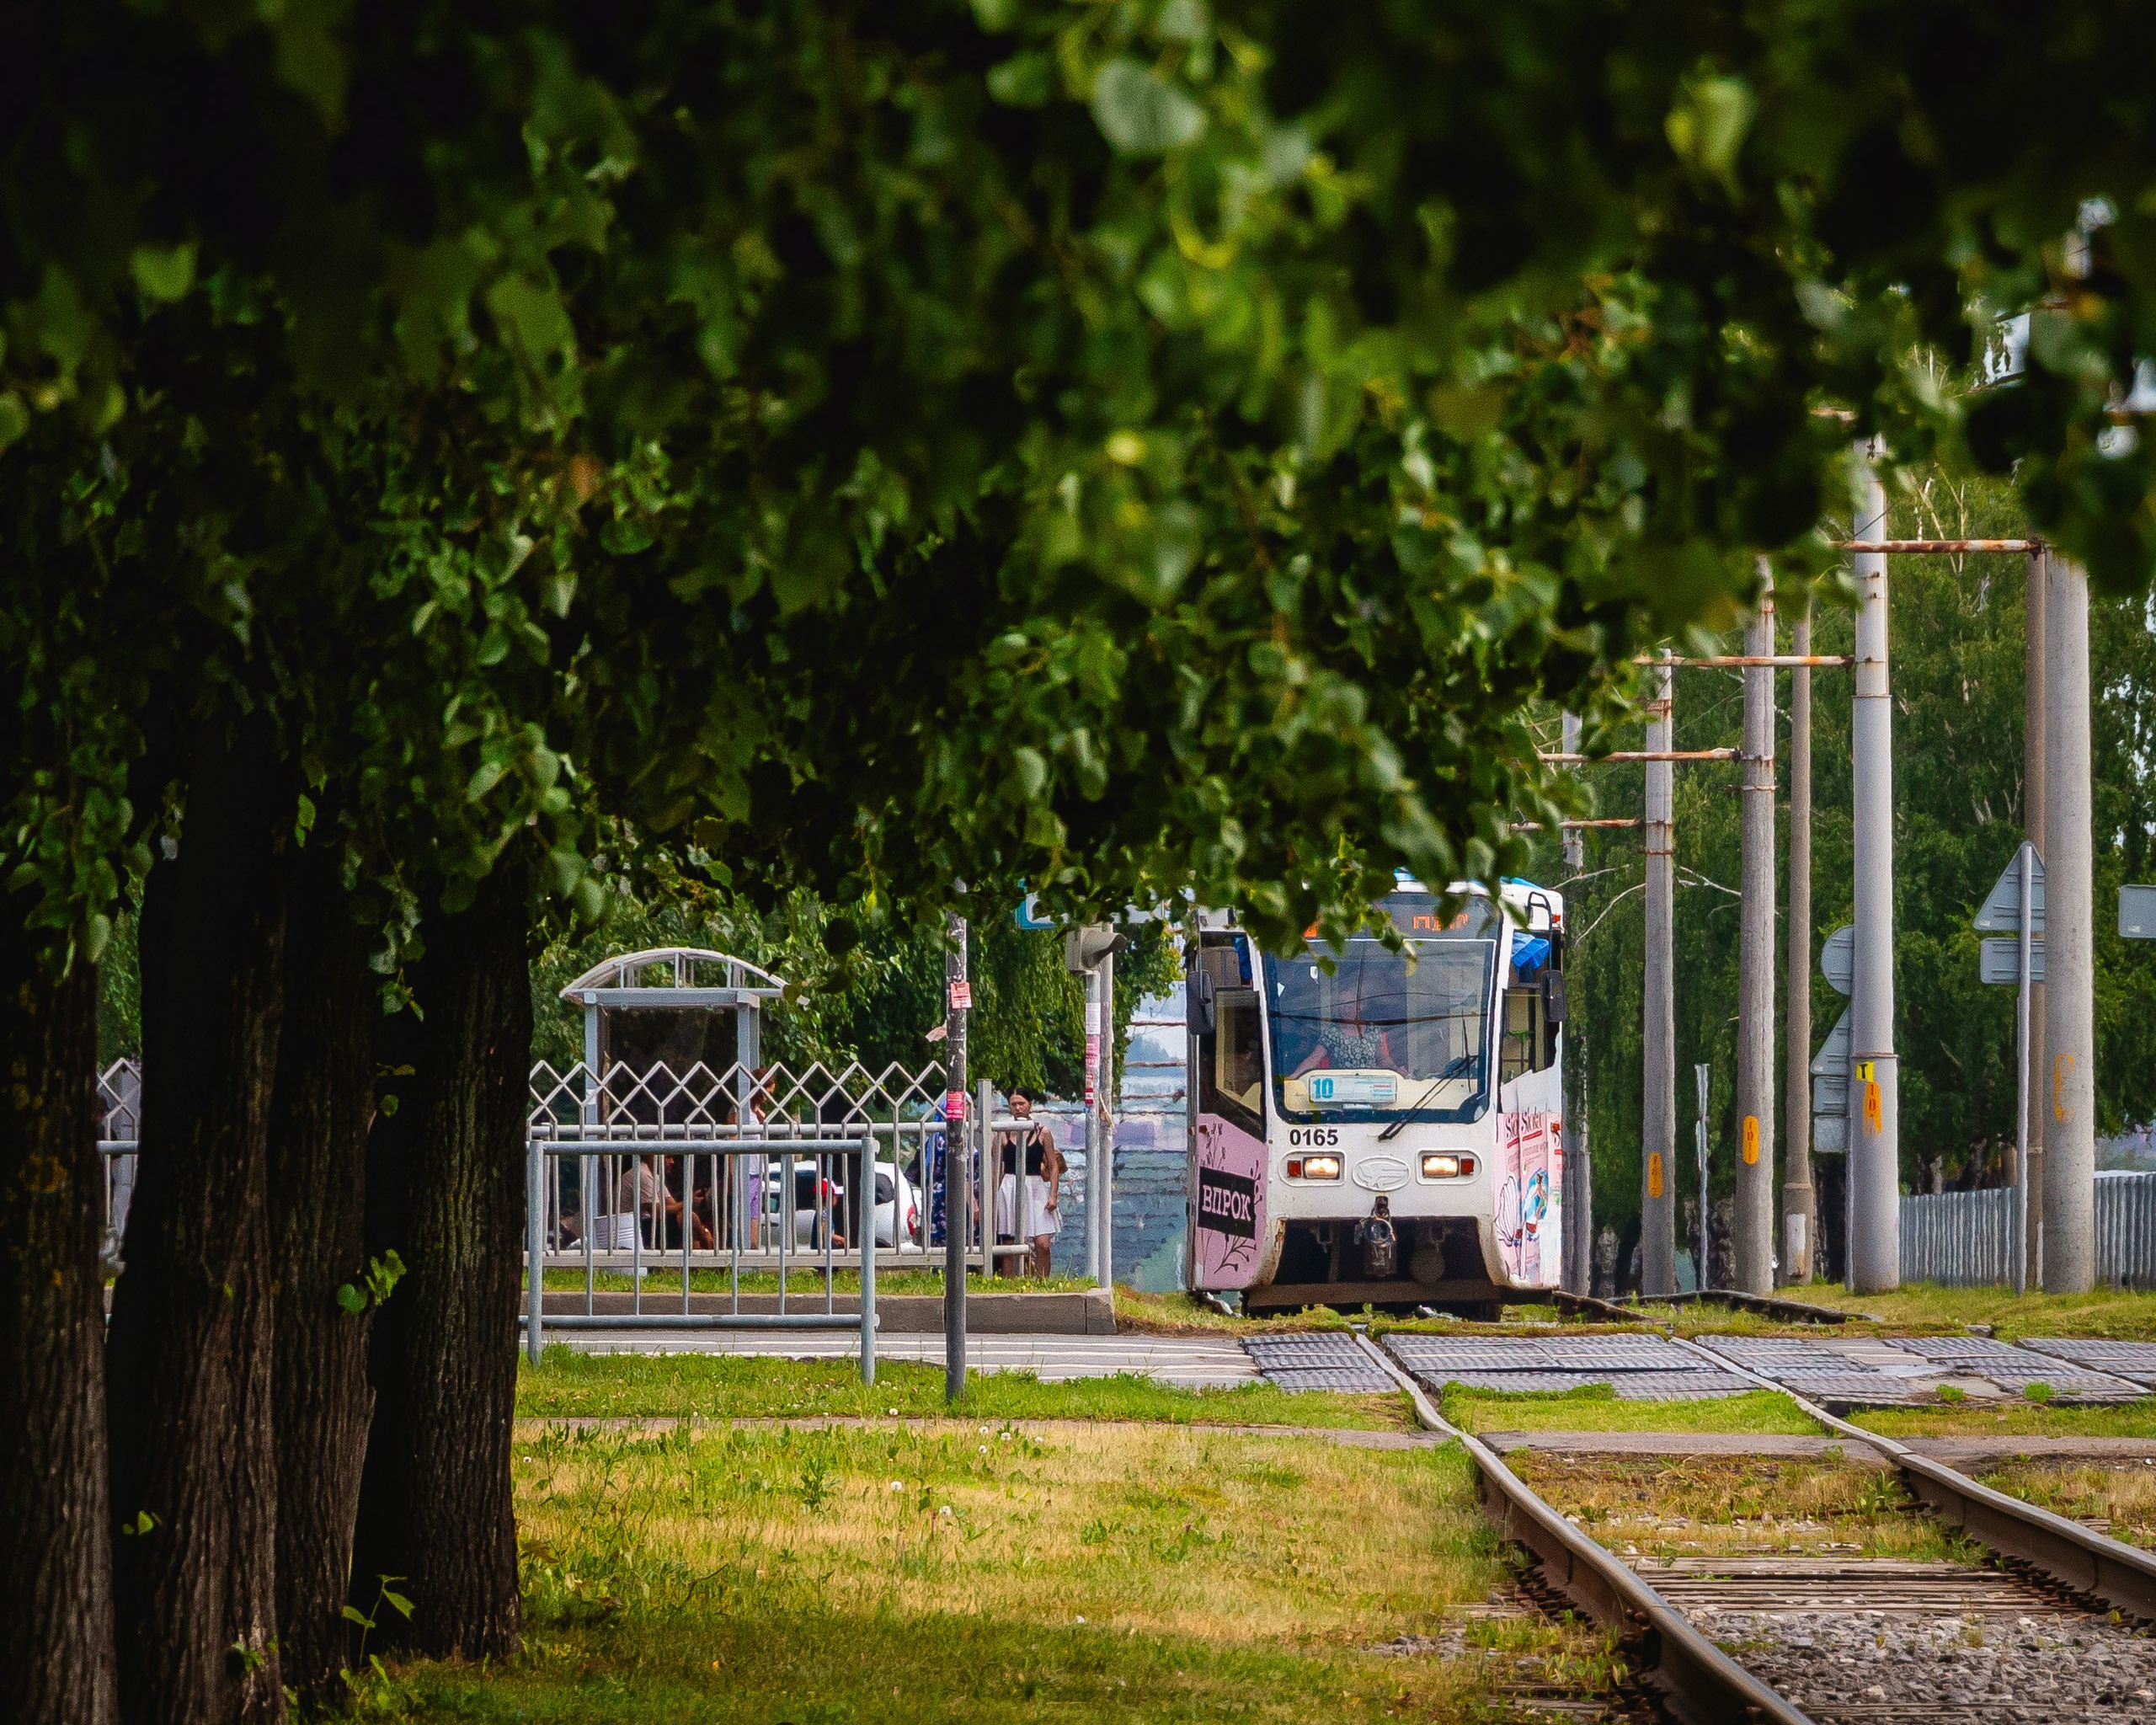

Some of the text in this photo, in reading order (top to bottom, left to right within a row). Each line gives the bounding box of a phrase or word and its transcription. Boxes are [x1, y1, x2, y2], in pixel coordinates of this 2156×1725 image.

[1312, 1077, 1334, 1099] 10
[1289, 1128, 1339, 1146] 0165
[1201, 1184, 1251, 1221] ВПРОК
